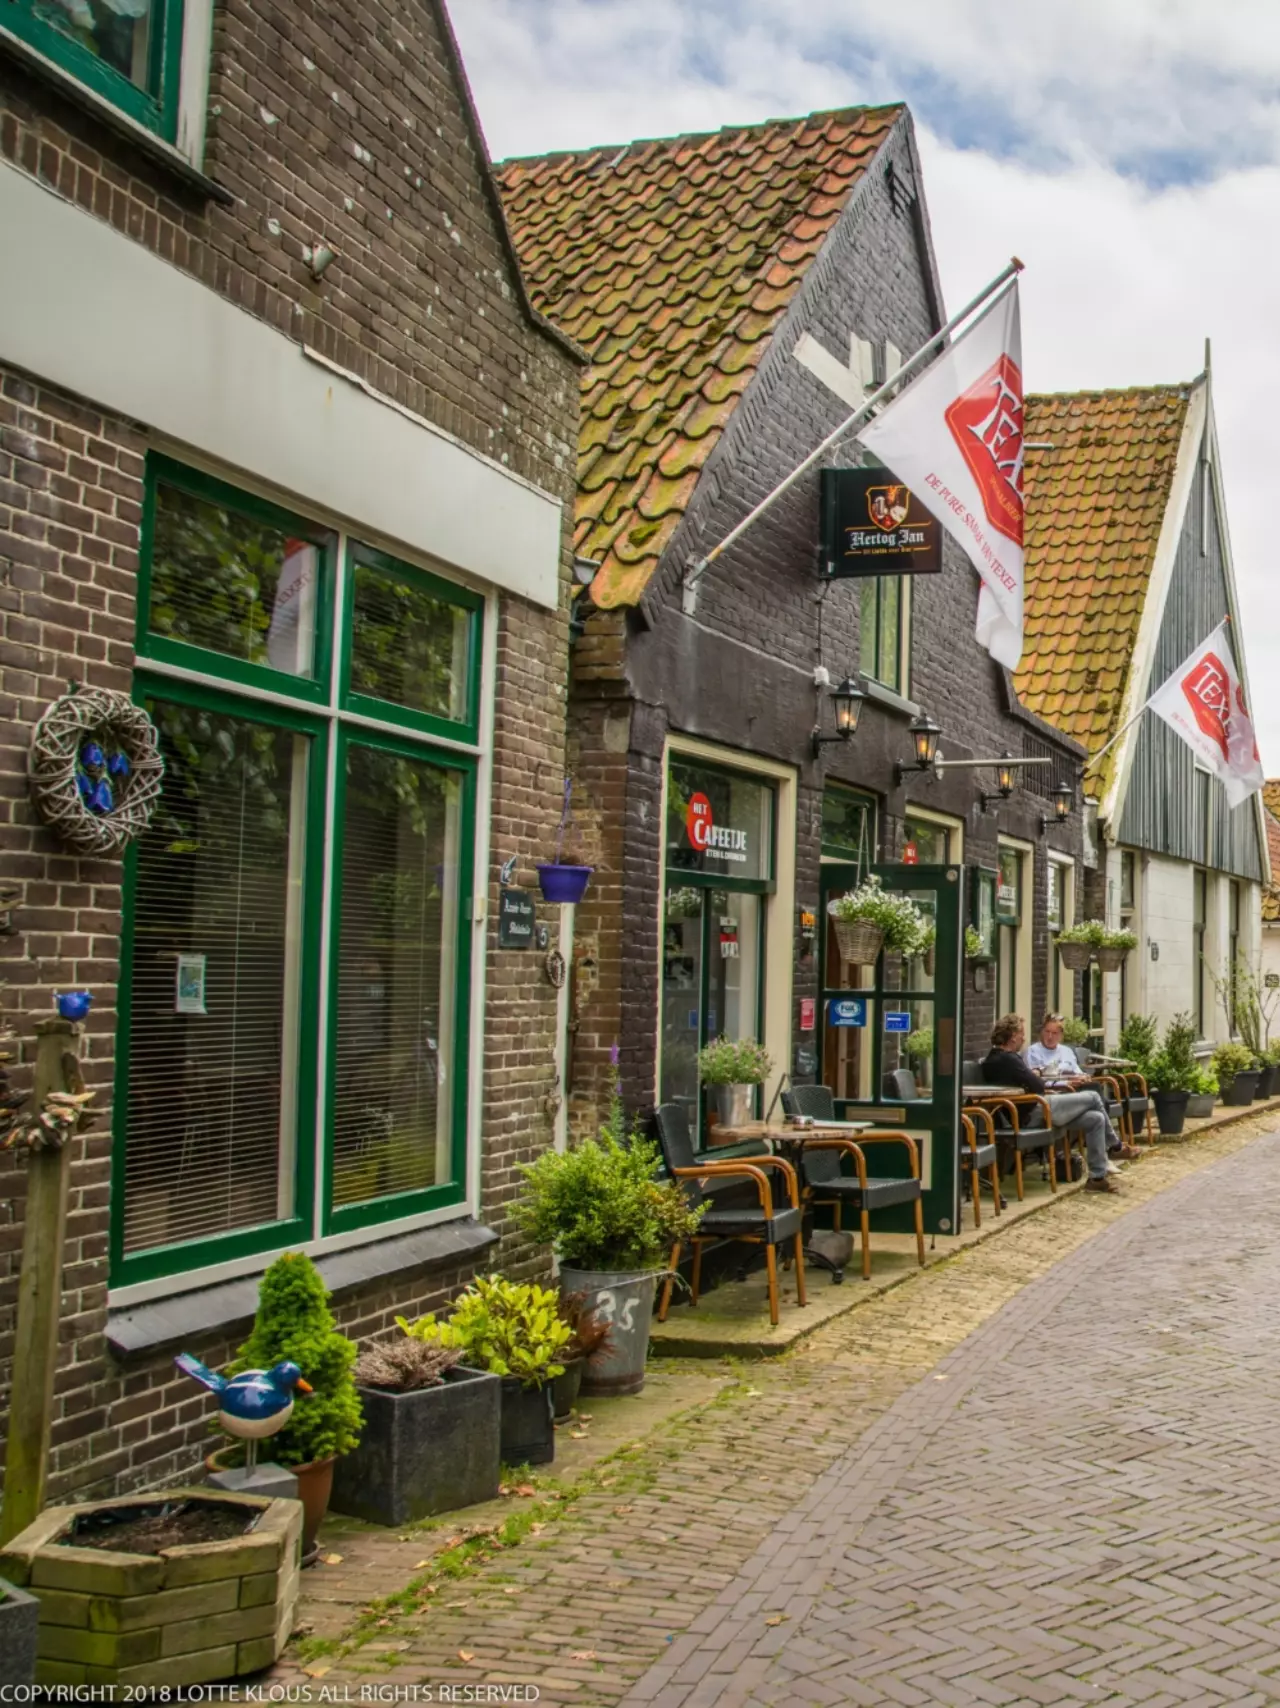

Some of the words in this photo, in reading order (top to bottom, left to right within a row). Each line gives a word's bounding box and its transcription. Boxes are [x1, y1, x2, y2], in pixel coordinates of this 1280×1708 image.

[850, 532, 897, 550] Hertog
[899, 529, 925, 548] Jan
[924, 472, 943, 491] DE
[939, 485, 967, 516] PURE
[990, 558, 1018, 594] TEXEL
[693, 802, 707, 816] HET
[694, 818, 747, 850] CAFEETJE
[540, 927, 548, 946] 5
